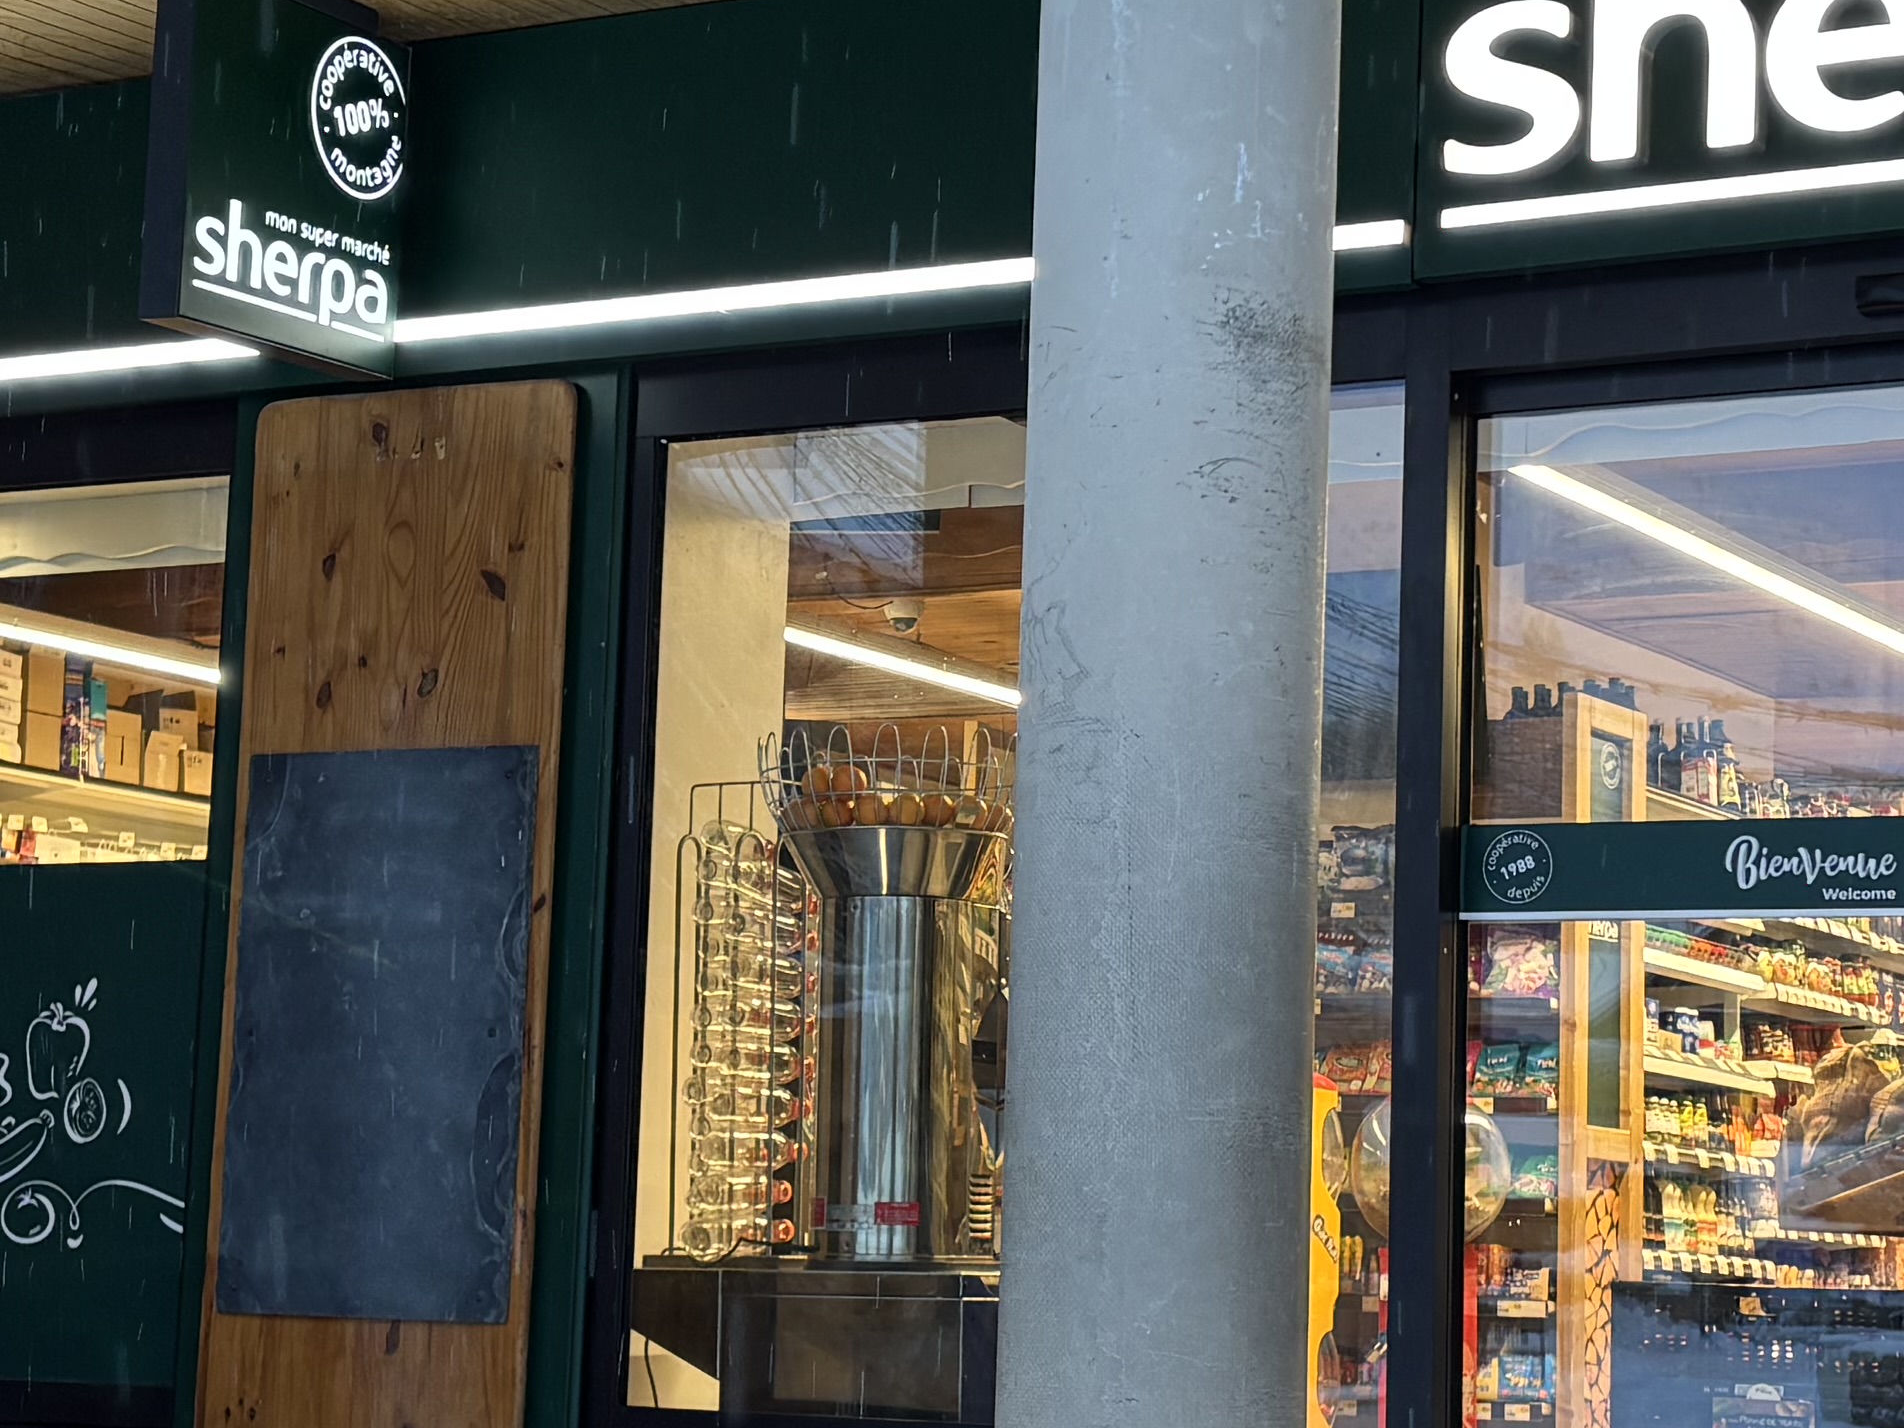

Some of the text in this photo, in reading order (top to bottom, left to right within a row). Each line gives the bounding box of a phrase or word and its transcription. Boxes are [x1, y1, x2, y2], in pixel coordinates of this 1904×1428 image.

[319, 44, 395, 109] coopérative
[333, 97, 390, 138] 100%
[330, 134, 402, 188] montagne
[265, 210, 391, 267] mon super marché
[193, 199, 388, 326] sherpa
[1487, 834, 1539, 871] coopérative
[1500, 855, 1535, 880] 1988
[1725, 834, 1897, 890] Bienvenue
[1507, 875, 1545, 901] depuis
[1822, 886, 1897, 901] Welcome
